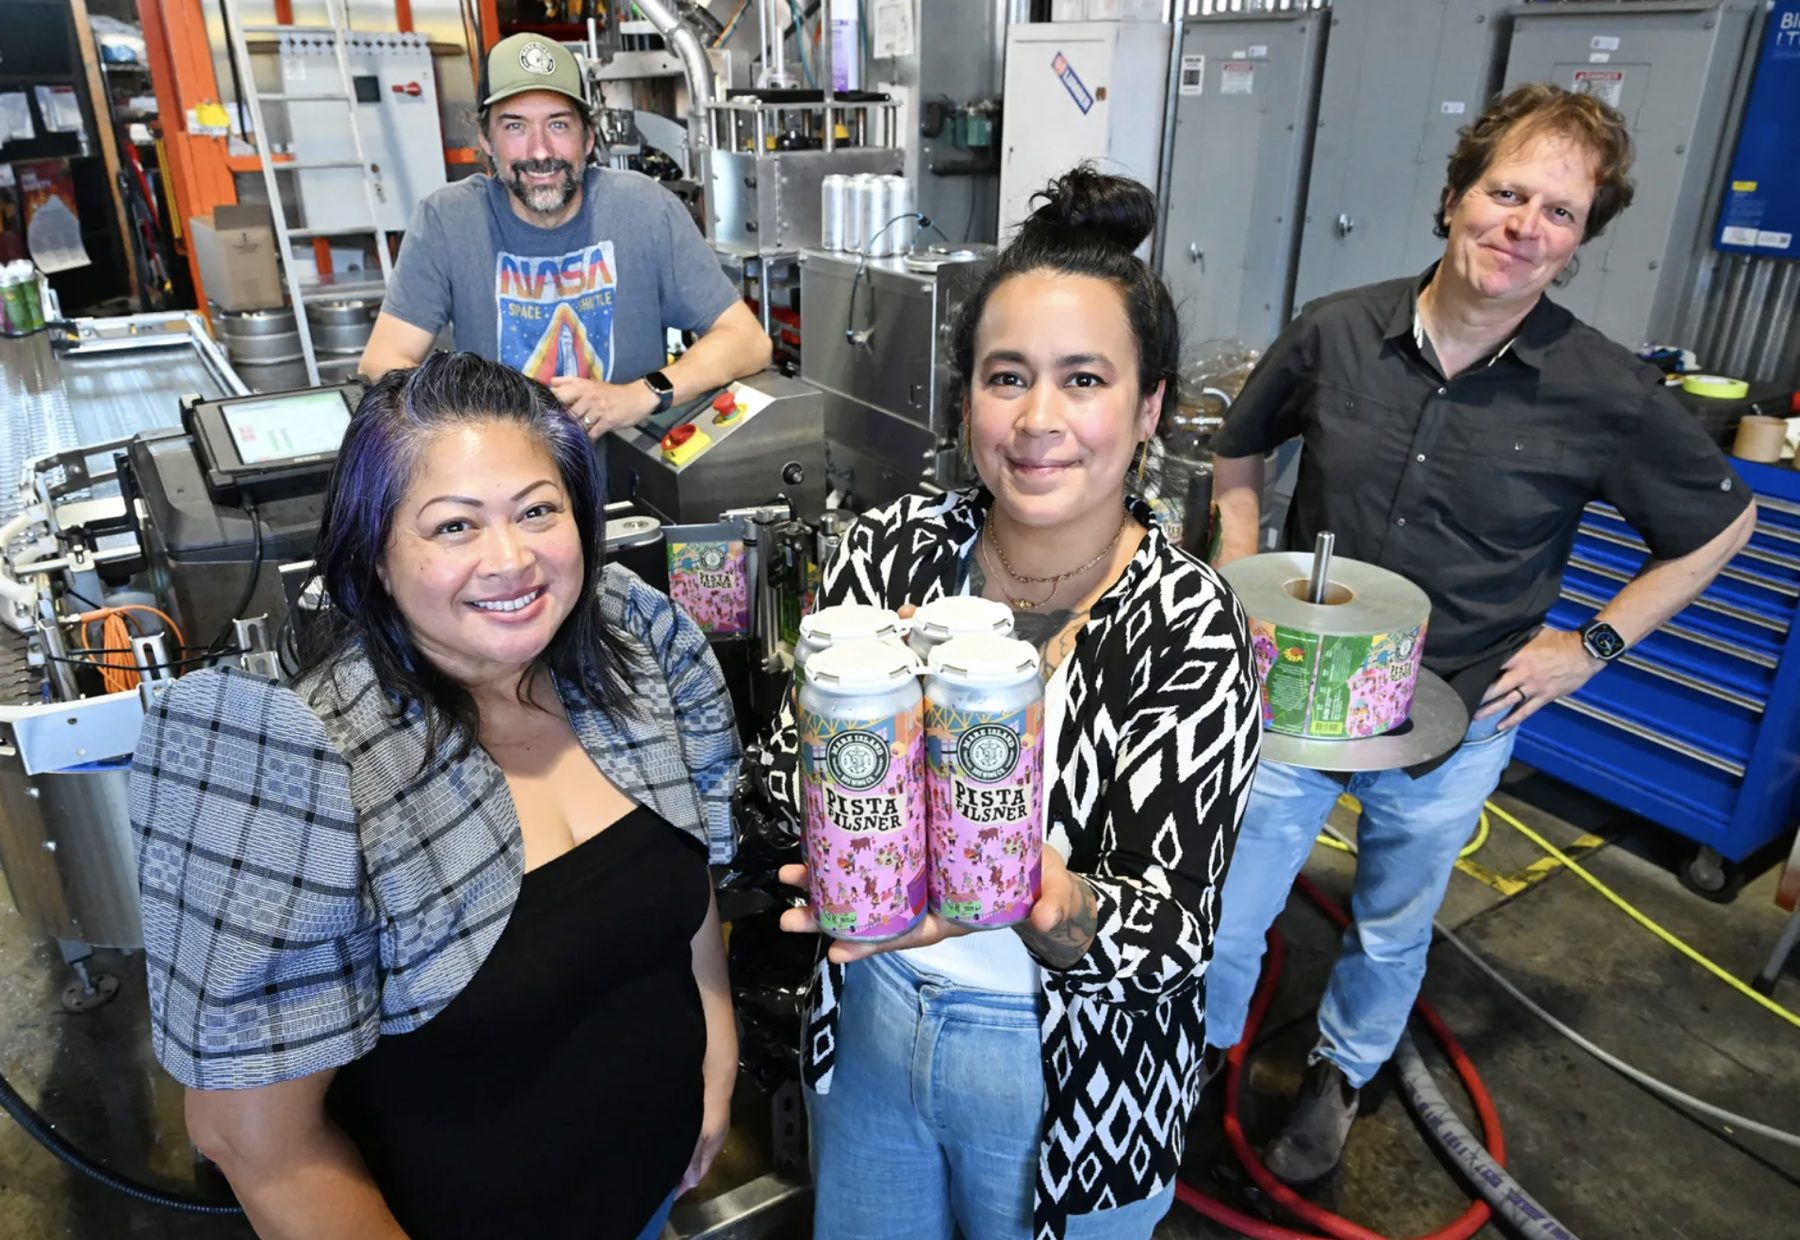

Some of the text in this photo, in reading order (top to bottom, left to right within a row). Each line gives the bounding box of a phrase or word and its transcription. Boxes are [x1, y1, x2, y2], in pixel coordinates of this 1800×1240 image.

[501, 248, 613, 299] NASA
[508, 303, 541, 319] SPACE
[826, 787, 898, 816] PISTA
[955, 780, 1025, 807] PISTA
[827, 806, 902, 832] PILSNER
[956, 799, 1028, 822] PILSNER
